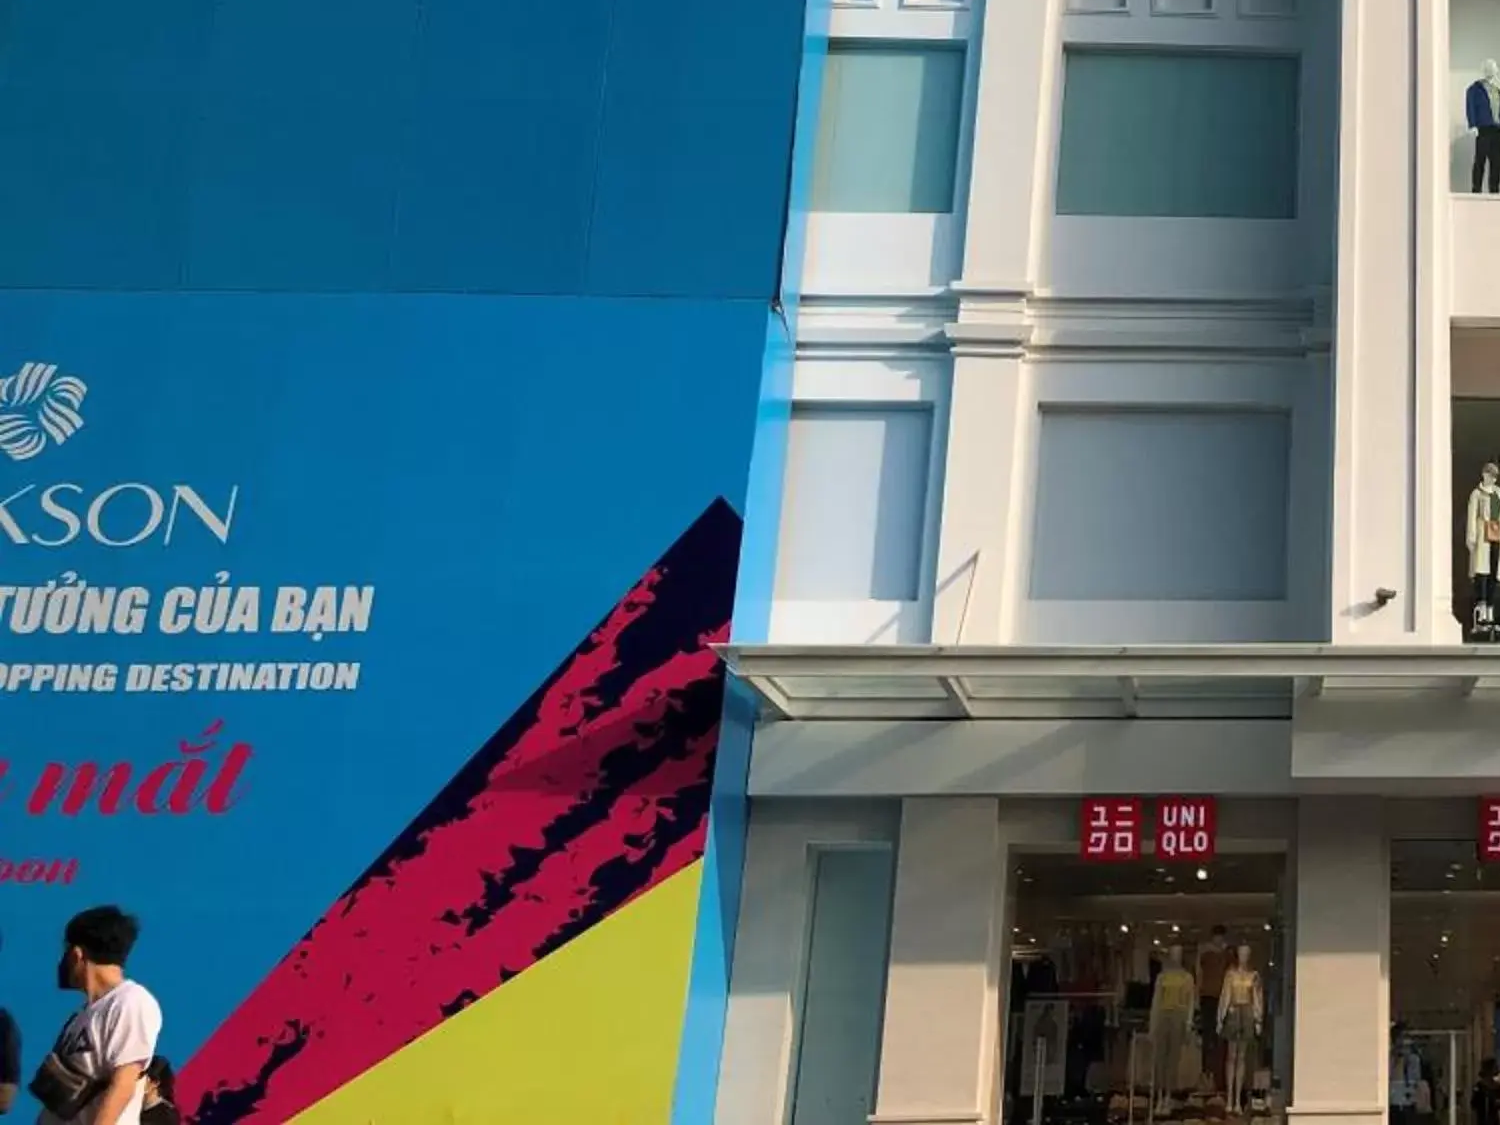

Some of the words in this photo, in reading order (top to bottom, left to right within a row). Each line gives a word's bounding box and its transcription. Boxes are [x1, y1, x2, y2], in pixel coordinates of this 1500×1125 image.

[159, 571, 260, 635] CỦA
[271, 586, 375, 642] BẠN
[124, 662, 361, 692] DESTINATION
[27, 718, 253, 816] mắt
[1163, 806, 1205, 828] UNI
[1161, 831, 1208, 856] QLO
